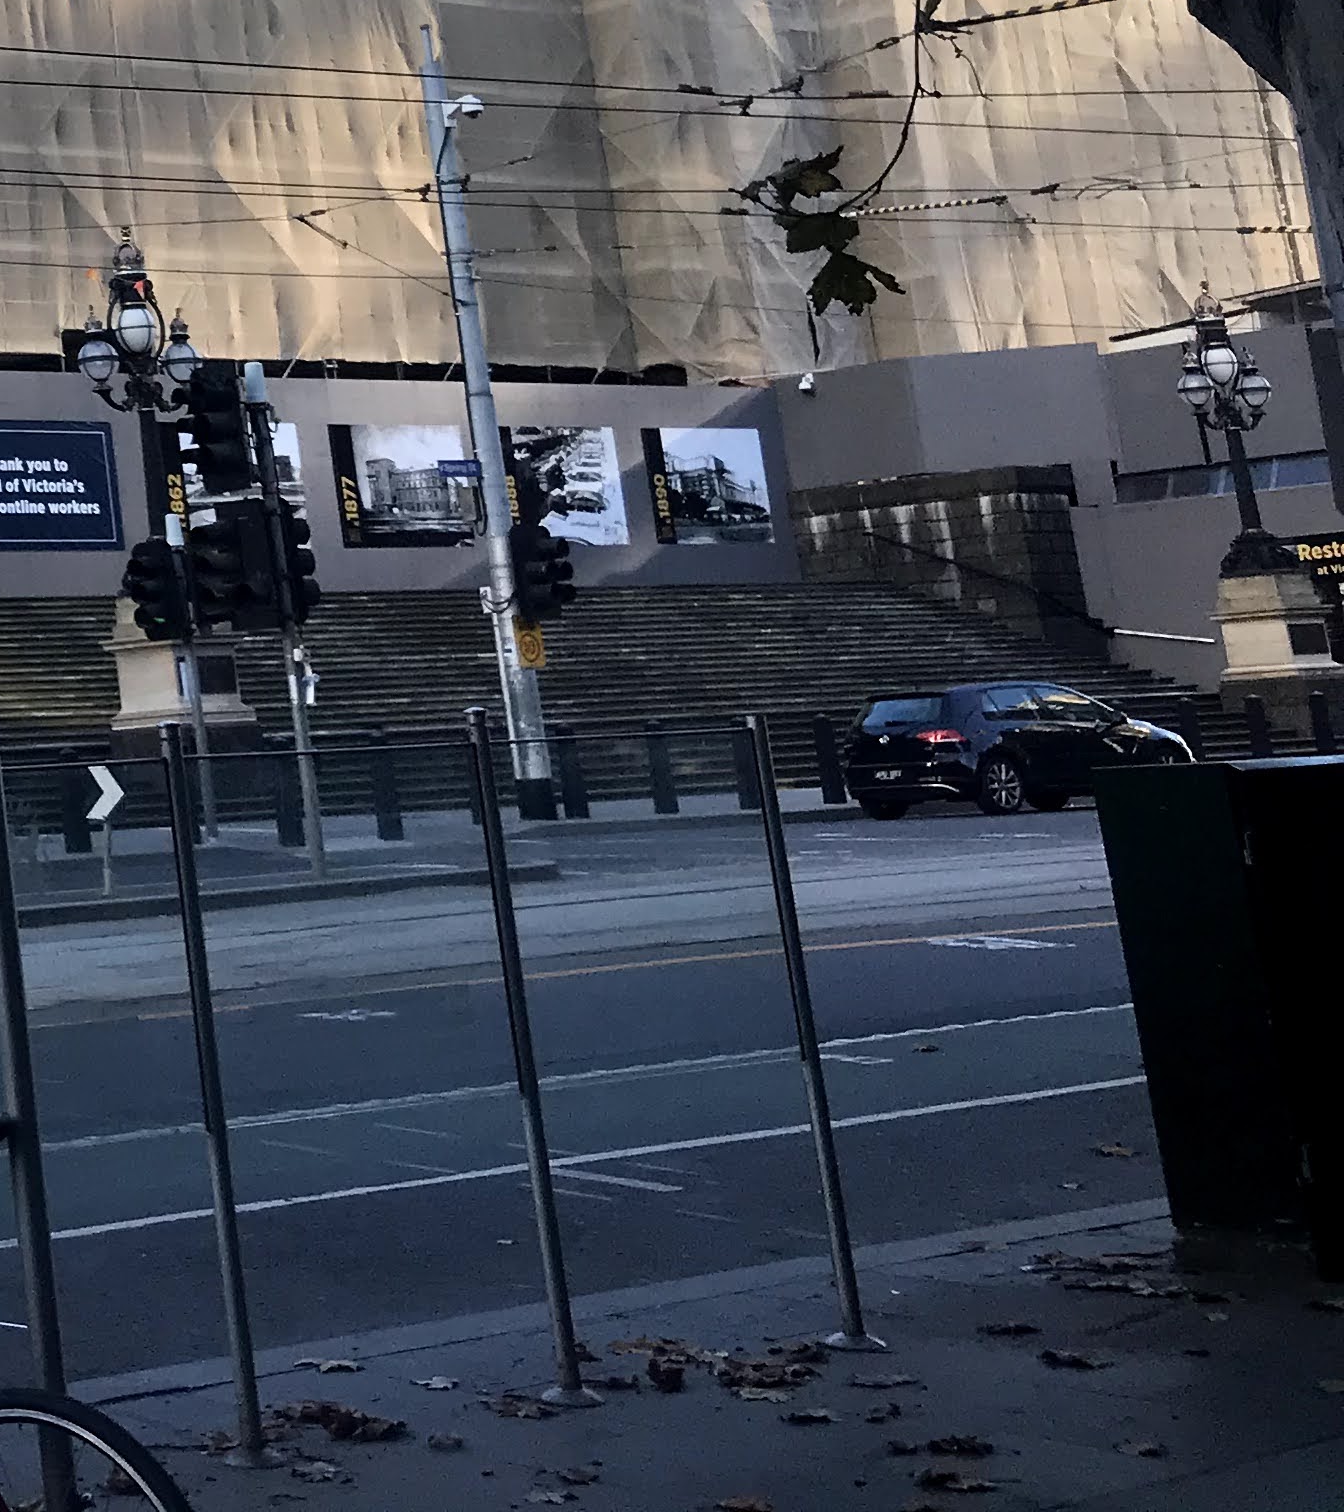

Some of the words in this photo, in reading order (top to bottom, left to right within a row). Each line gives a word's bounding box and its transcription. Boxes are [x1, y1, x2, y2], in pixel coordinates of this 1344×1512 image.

[26, 460, 51, 474] you
[53, 458, 69, 472] to
[5, 478, 20, 493] of
[22, 478, 86, 494] Victoria's
[48, 500, 101, 515] workers
